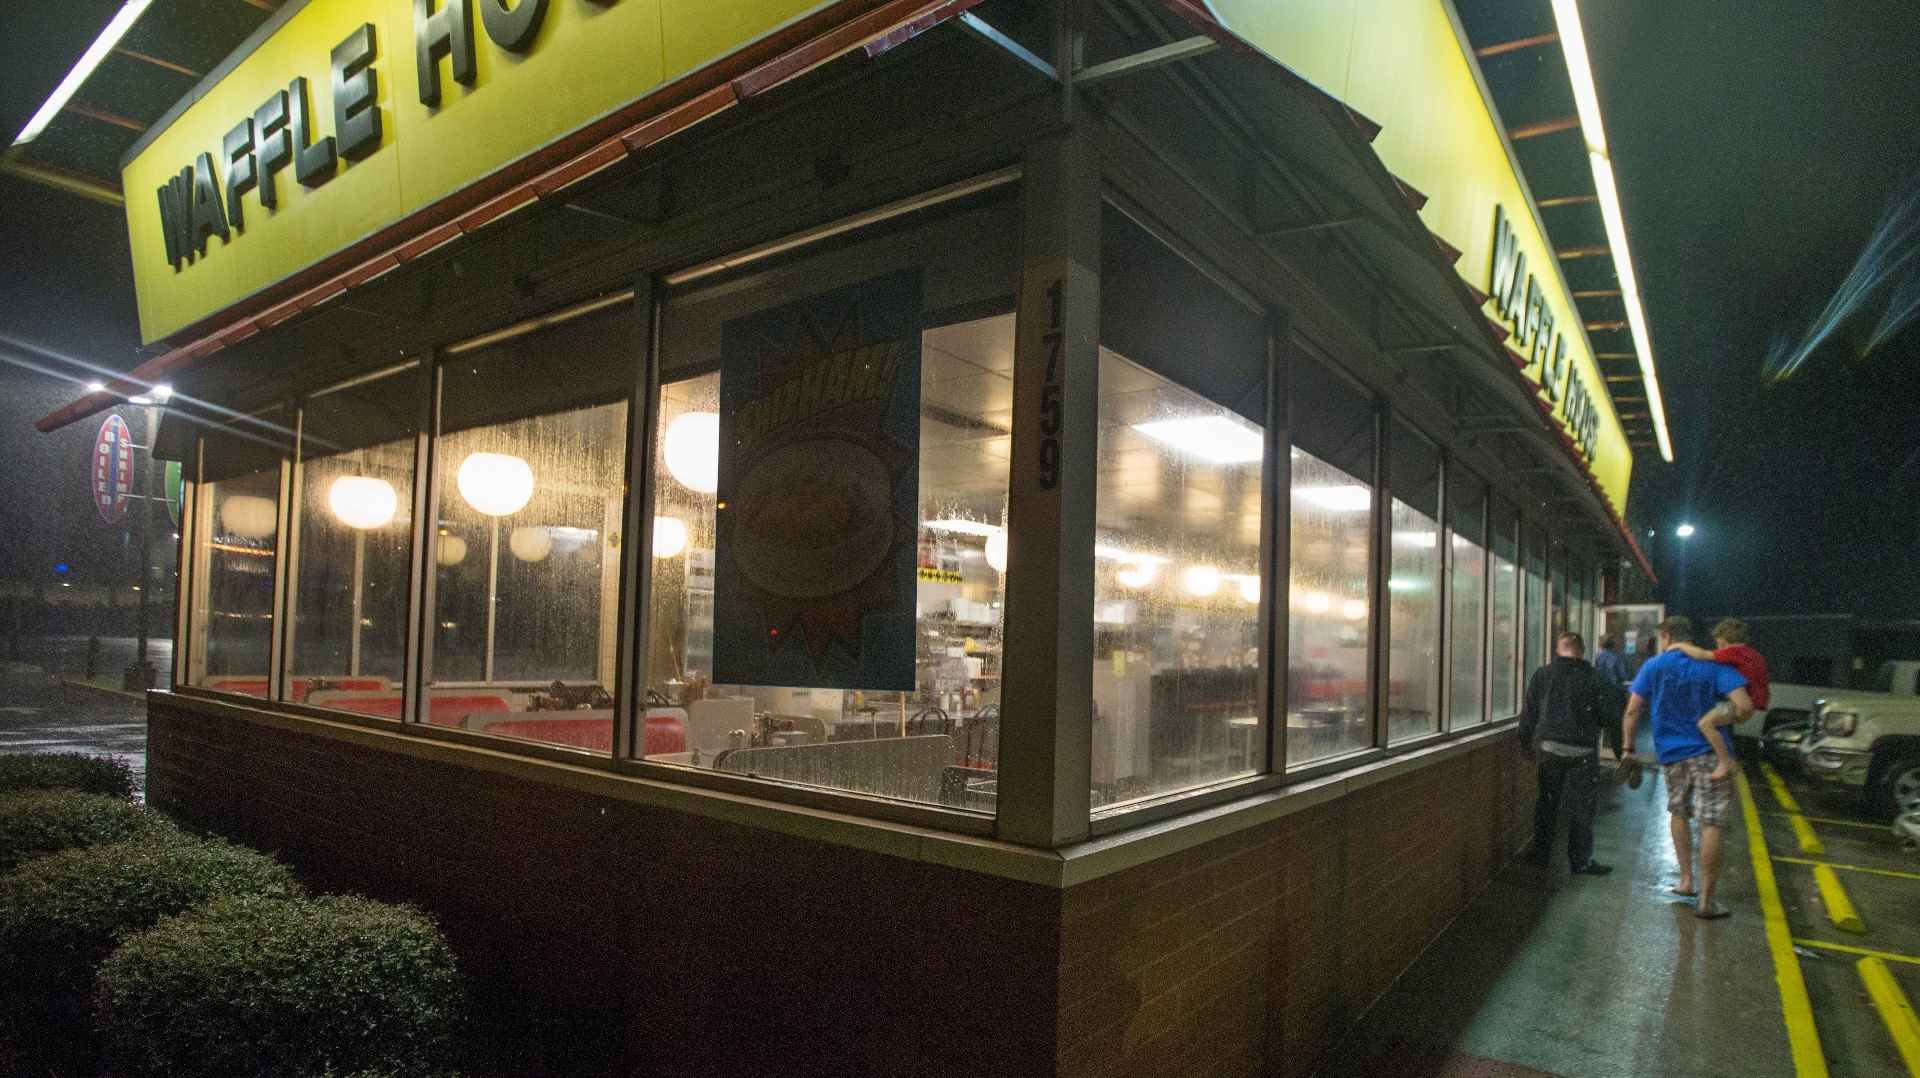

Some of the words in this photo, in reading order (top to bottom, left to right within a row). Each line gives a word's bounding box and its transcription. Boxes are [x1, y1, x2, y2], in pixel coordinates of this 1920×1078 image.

[157, 22, 382, 270] WAFFLE
[1039, 279, 1062, 490] 1759
[1490, 203, 1568, 402] WAFFLE
[98, 431, 115, 505] BOILED
